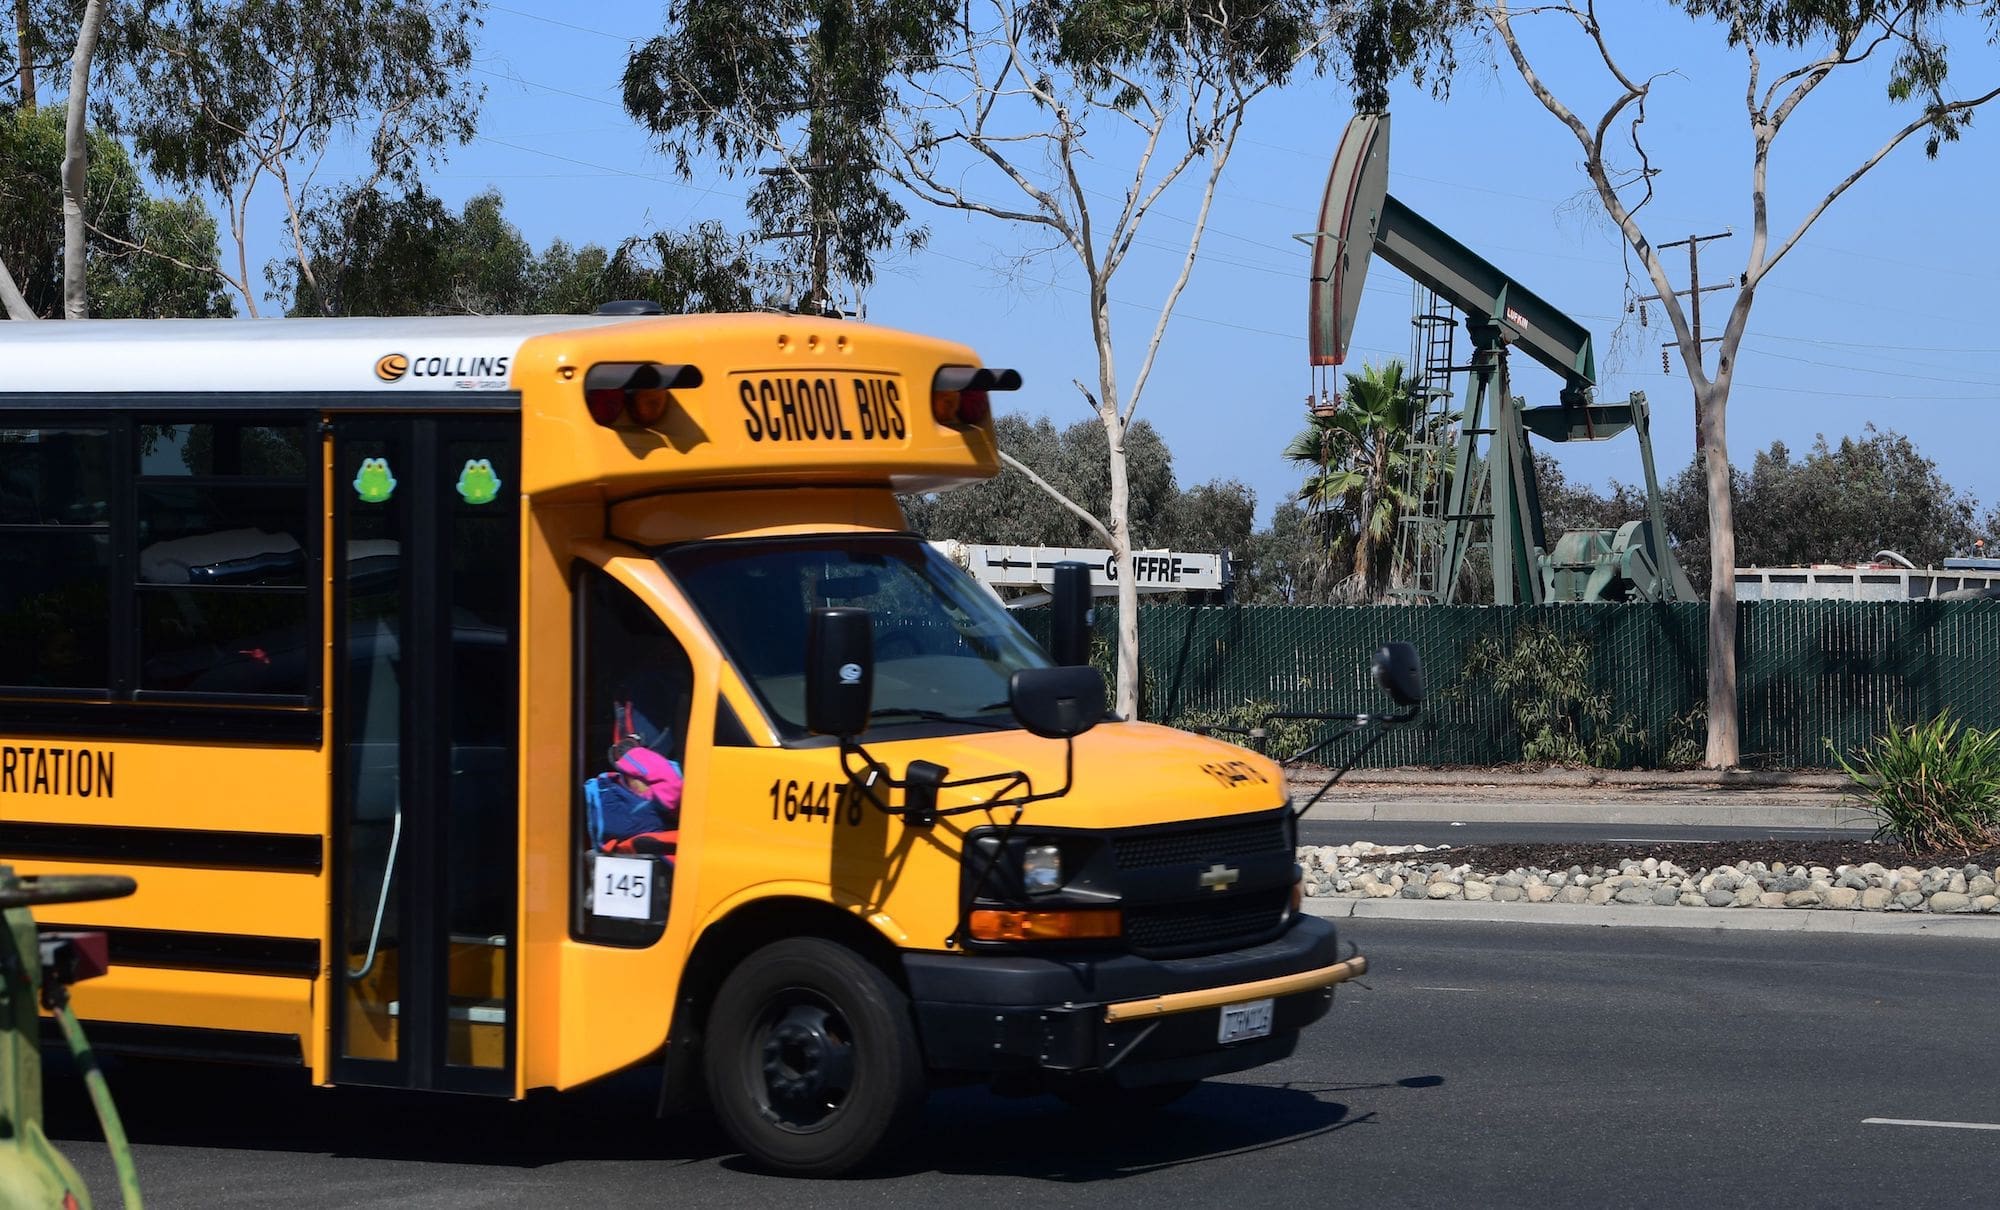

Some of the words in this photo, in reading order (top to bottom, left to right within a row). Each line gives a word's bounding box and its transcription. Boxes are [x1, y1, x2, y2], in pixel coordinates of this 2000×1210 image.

[413, 357, 508, 377] COLLINS
[740, 378, 853, 442] SCHOOL
[853, 379, 906, 441] BUS
[2, 746, 114, 798] RTATION
[769, 779, 863, 827] 164478
[605, 873, 646, 898] 145
